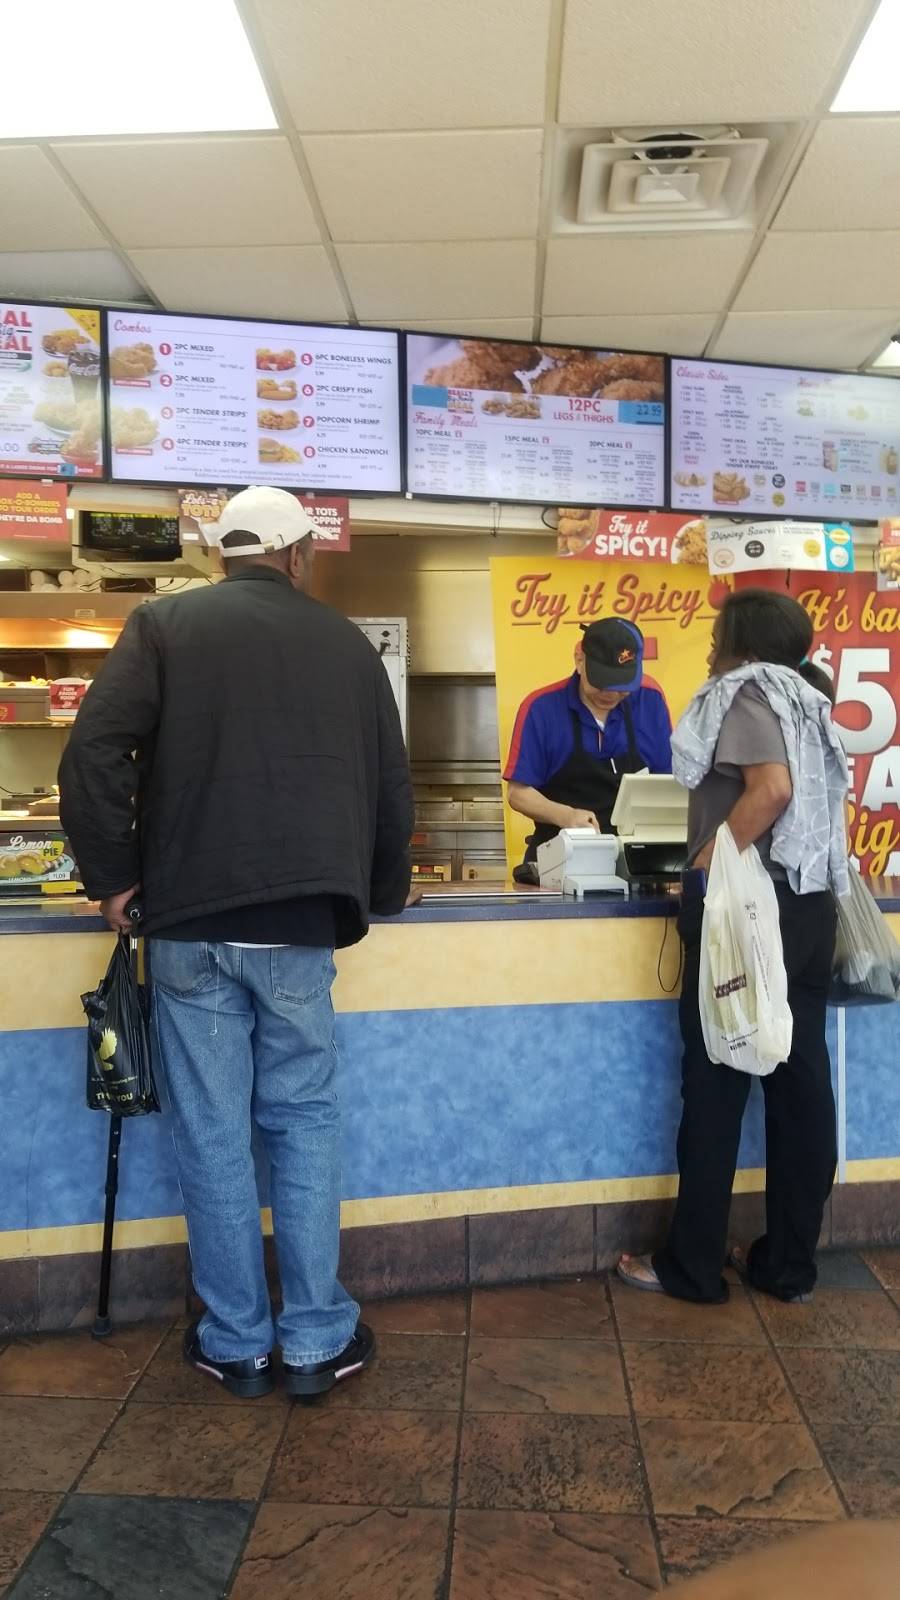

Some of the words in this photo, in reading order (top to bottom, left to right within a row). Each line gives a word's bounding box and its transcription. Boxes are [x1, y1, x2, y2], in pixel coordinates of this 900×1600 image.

[0, 310, 32, 327] AL
[0, 335, 32, 351] AL
[190, 345, 215, 353] MIXED
[330, 355, 366, 364] BONELESS
[367, 357, 392, 365] WINGS
[331, 386, 355, 394] CRISPY
[568, 399, 600, 412] 12PC
[192, 408, 220, 417] TENDER
[554, 412, 574, 421] LEGS
[584, 414, 614, 424] THIGHS
[317, 416, 352, 424] POPCORN
[354, 418, 380, 426] SHRIMP
[413, 411, 446, 428] Family
[450, 414, 478, 428] Meals
[193, 440, 220, 448] TENDER
[318, 446, 349, 454] CHICKEN
[351, 448, 389, 456] SANDWICH
[181, 504, 220, 517] TOTS
[315, 507, 337, 516] TOTS
[608, 515, 633, 541] Try
[635, 520, 649, 534] it
[710, 530, 744, 541] Dipping
[747, 526, 776, 536] Sauces
[595, 535, 667, 557] SPICY!
[510, 573, 570, 634] Try
[577, 582, 605, 615] it
[612, 573, 703, 629] Spicy
[860, 591, 900, 632] ba
[7, 835, 53, 851] Lemon
[43, 848, 59, 856] PIE
